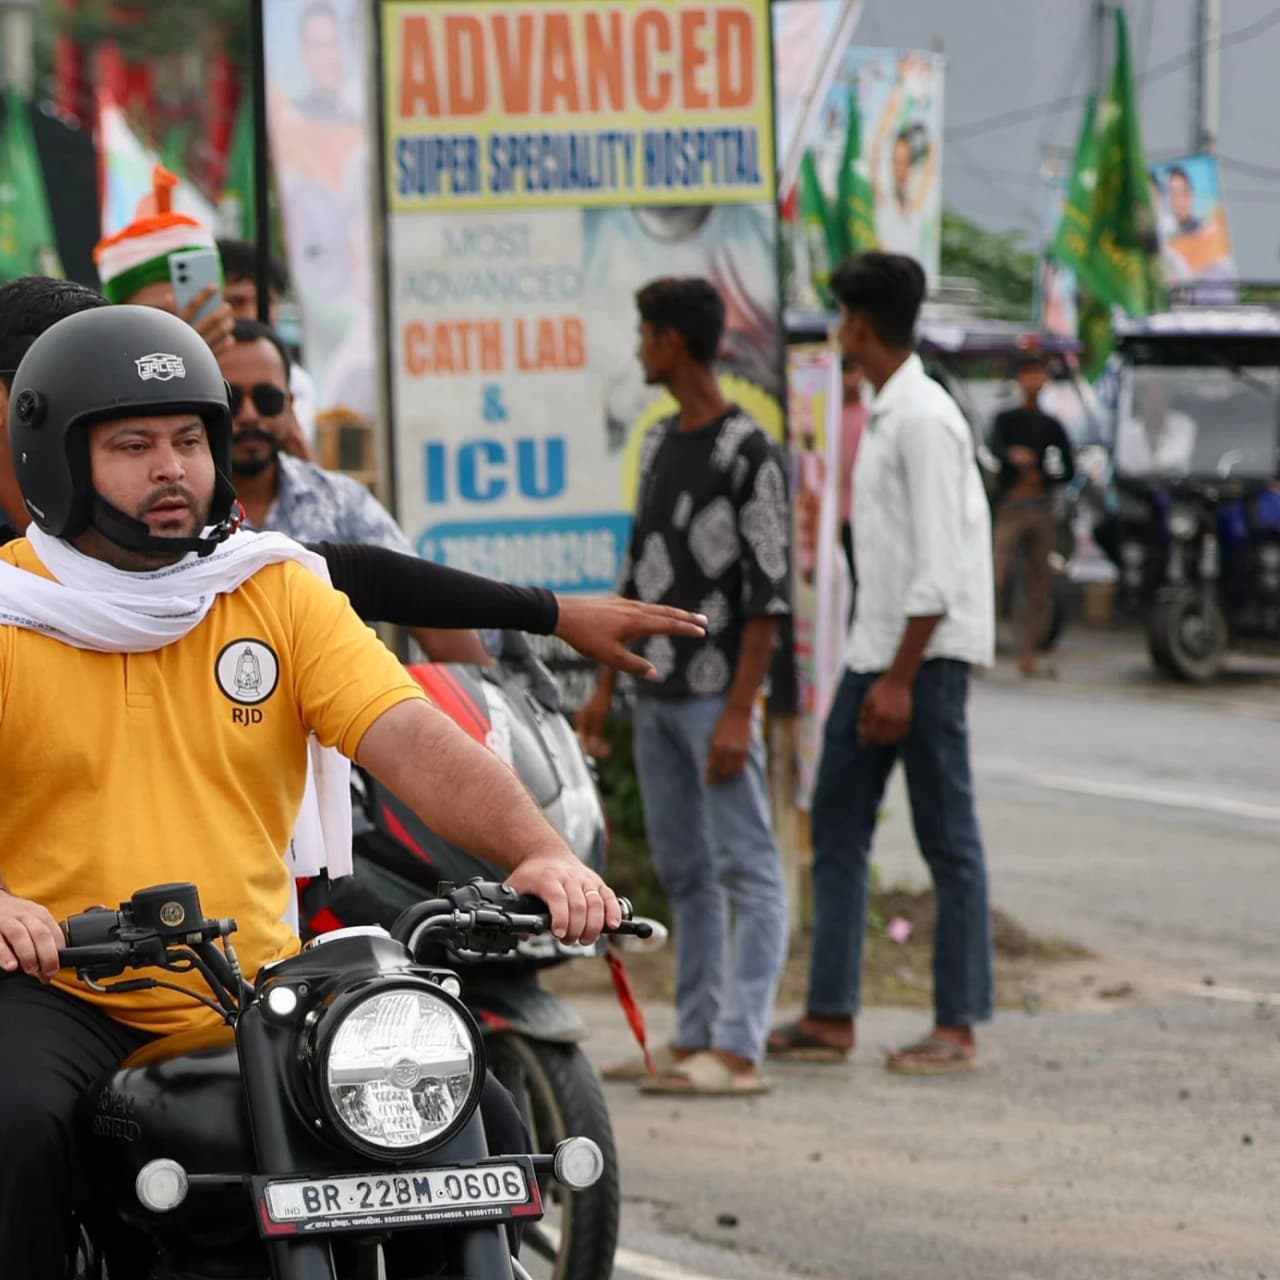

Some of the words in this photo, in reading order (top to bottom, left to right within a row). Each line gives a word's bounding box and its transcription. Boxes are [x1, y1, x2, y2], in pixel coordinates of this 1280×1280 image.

[398, 8, 755, 118] ADVANCED
[397, 134, 480, 195] SUPER
[490, 129, 633, 192] SPECIALITY
[643, 125, 761, 187] HOSPITAL
[442, 223, 532, 257] MOST
[403, 264, 585, 305] ADVANCED
[404, 319, 505, 378] CATH
[514, 313, 587, 372] LAB
[480, 381, 509, 423] &
[425, 437, 566, 504] ICU
[232, 708, 263, 727] RJD
[284, 1206, 301, 1216] IND
[302, 1185, 340, 1213] BR
[357, 1177, 432, 1209] 22BM
[445, 1171, 521, 1200] 0606
